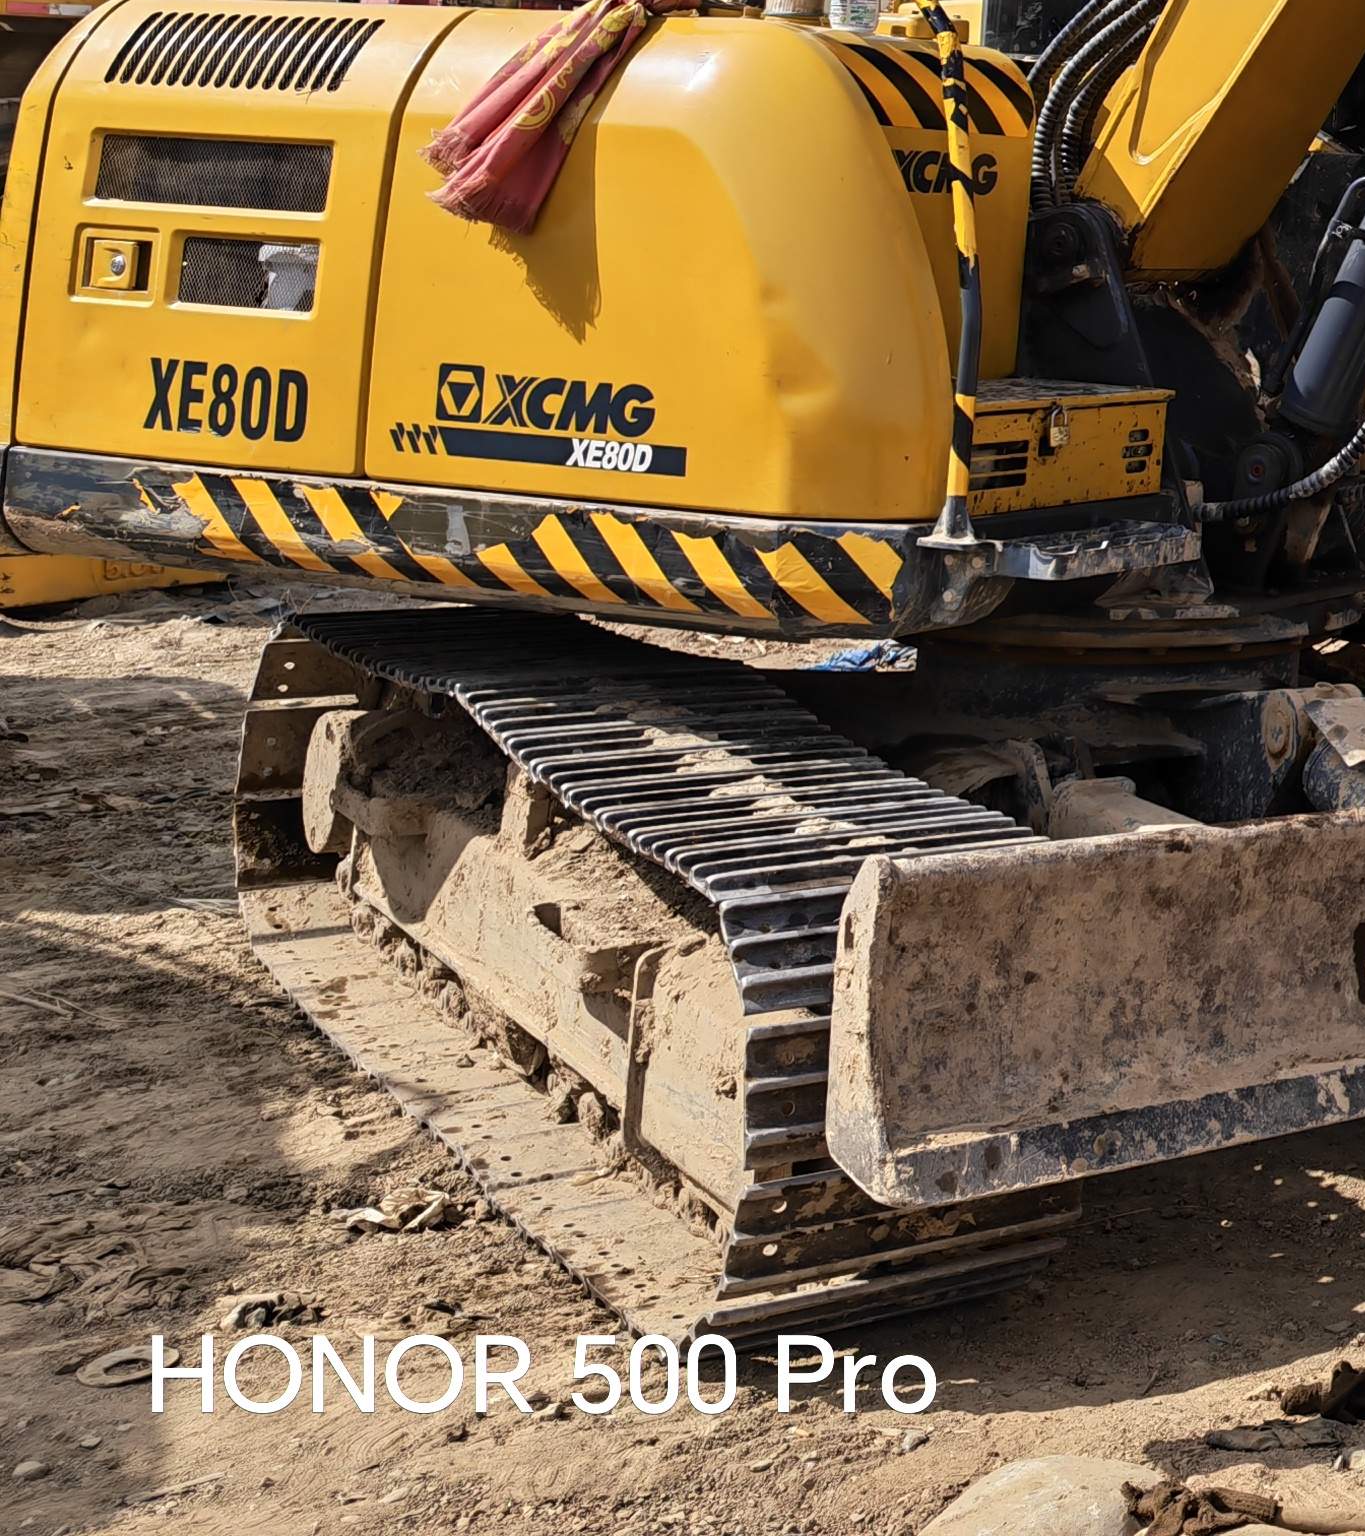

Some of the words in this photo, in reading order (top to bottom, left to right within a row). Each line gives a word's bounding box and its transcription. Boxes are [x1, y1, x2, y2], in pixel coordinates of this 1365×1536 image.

[143, 357, 308, 442] XE80D
[482, 374, 656, 437] XCMG
[566, 438, 653, 473] XE80D
